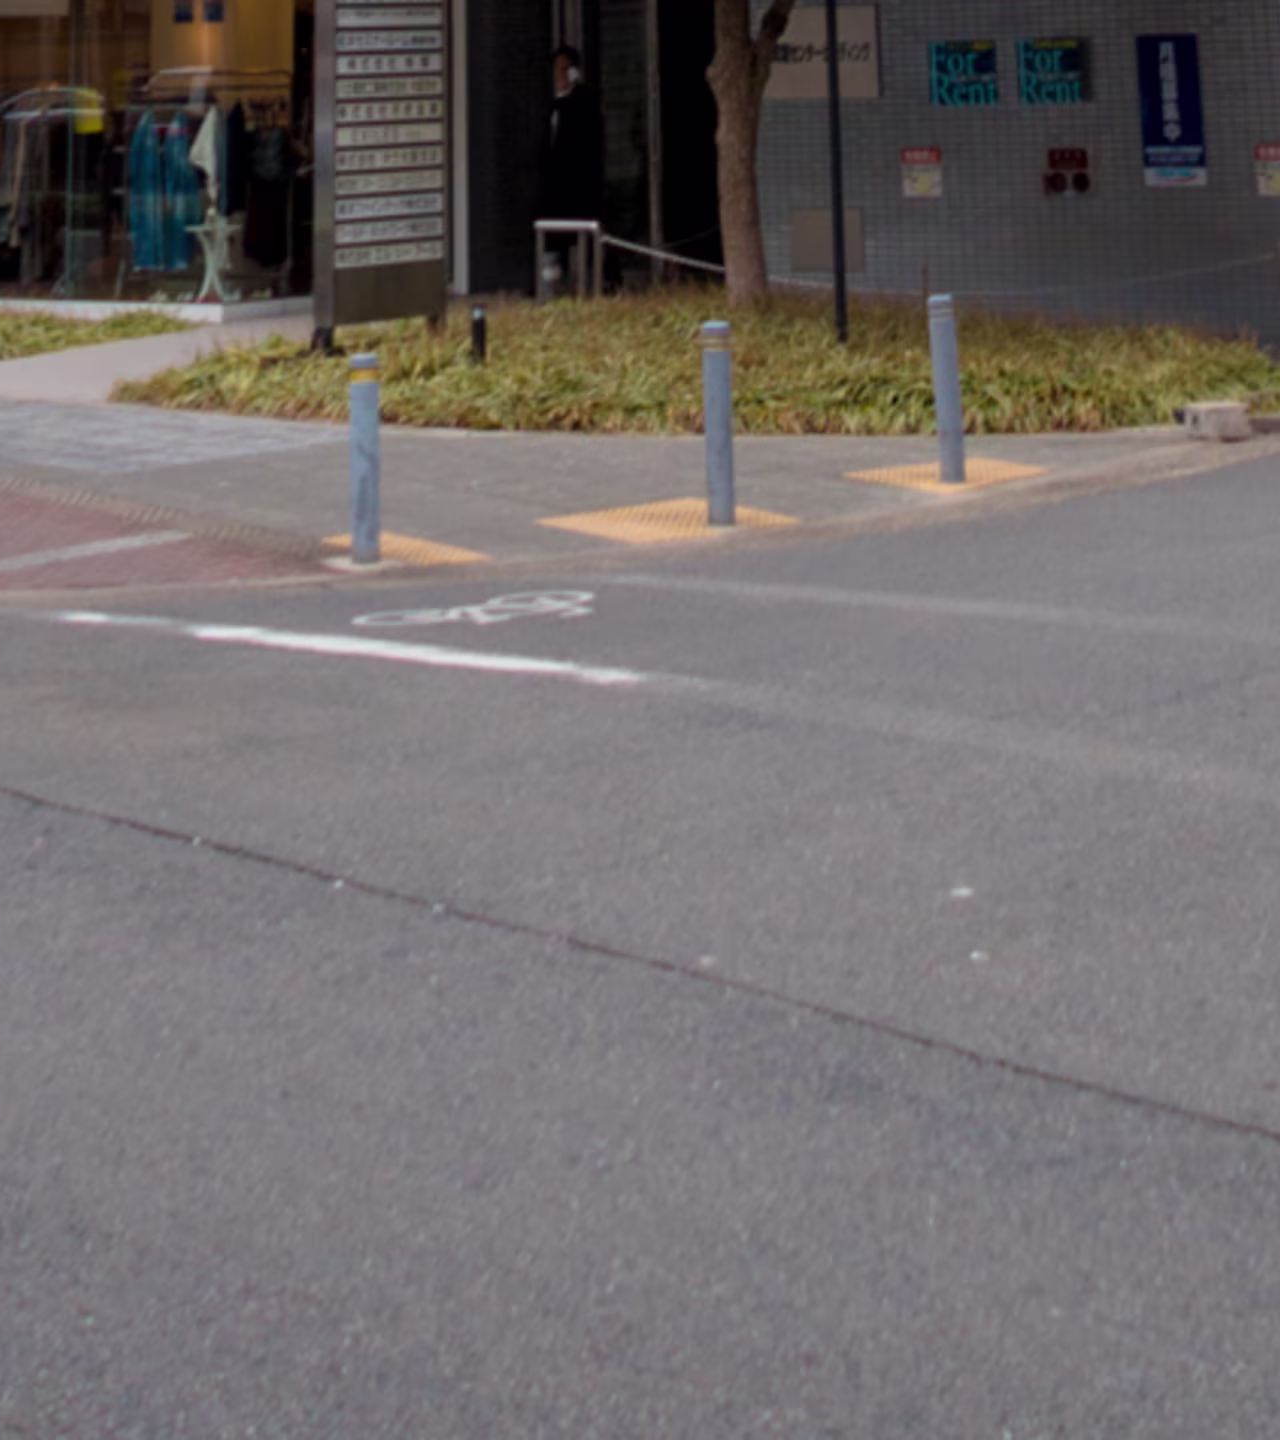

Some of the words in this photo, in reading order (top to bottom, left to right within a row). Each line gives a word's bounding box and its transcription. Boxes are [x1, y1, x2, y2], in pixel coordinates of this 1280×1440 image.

[928, 41, 978, 74] For
[1018, 40, 1063, 71] For
[930, 73, 995, 106] Rent
[1020, 71, 1082, 105] Rent
